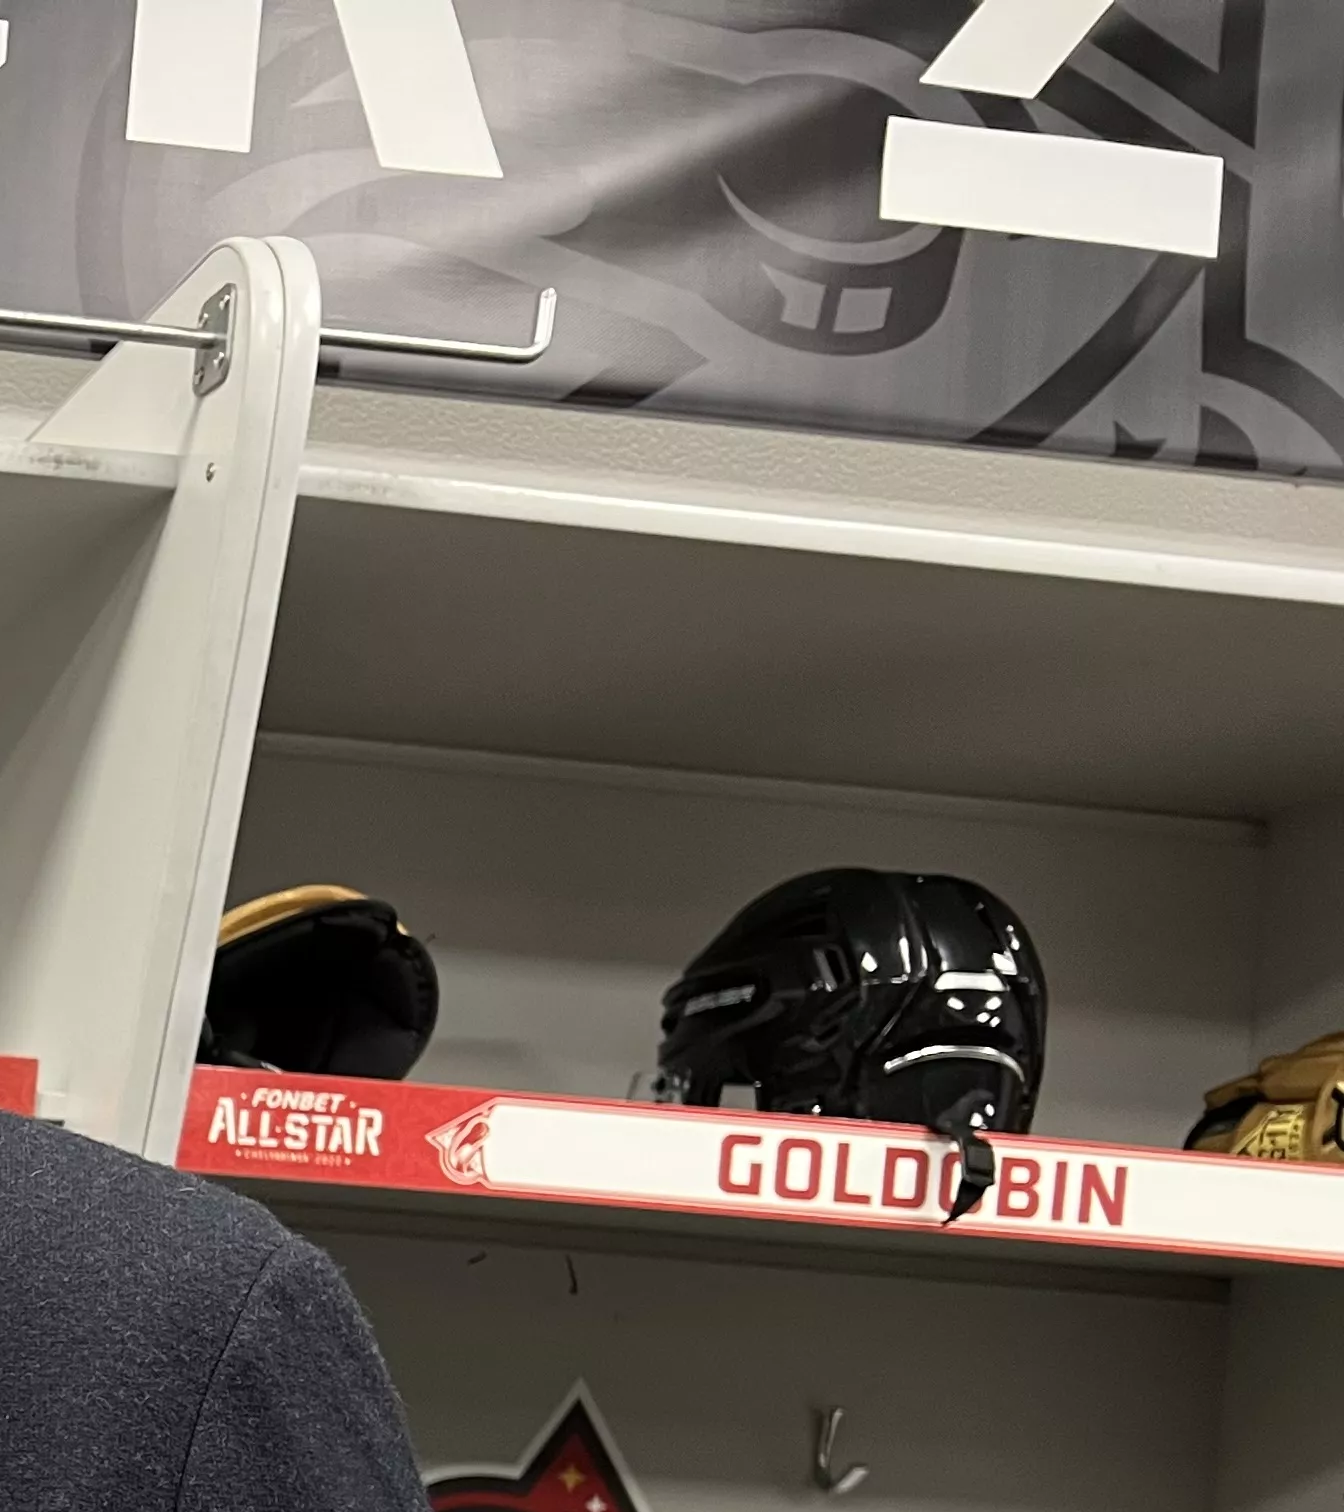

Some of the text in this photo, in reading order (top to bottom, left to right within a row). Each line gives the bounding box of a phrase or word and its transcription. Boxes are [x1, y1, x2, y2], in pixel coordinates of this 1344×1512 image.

[252, 1087, 345, 1113] FONBET
[208, 1097, 383, 1156] ALL STAR
